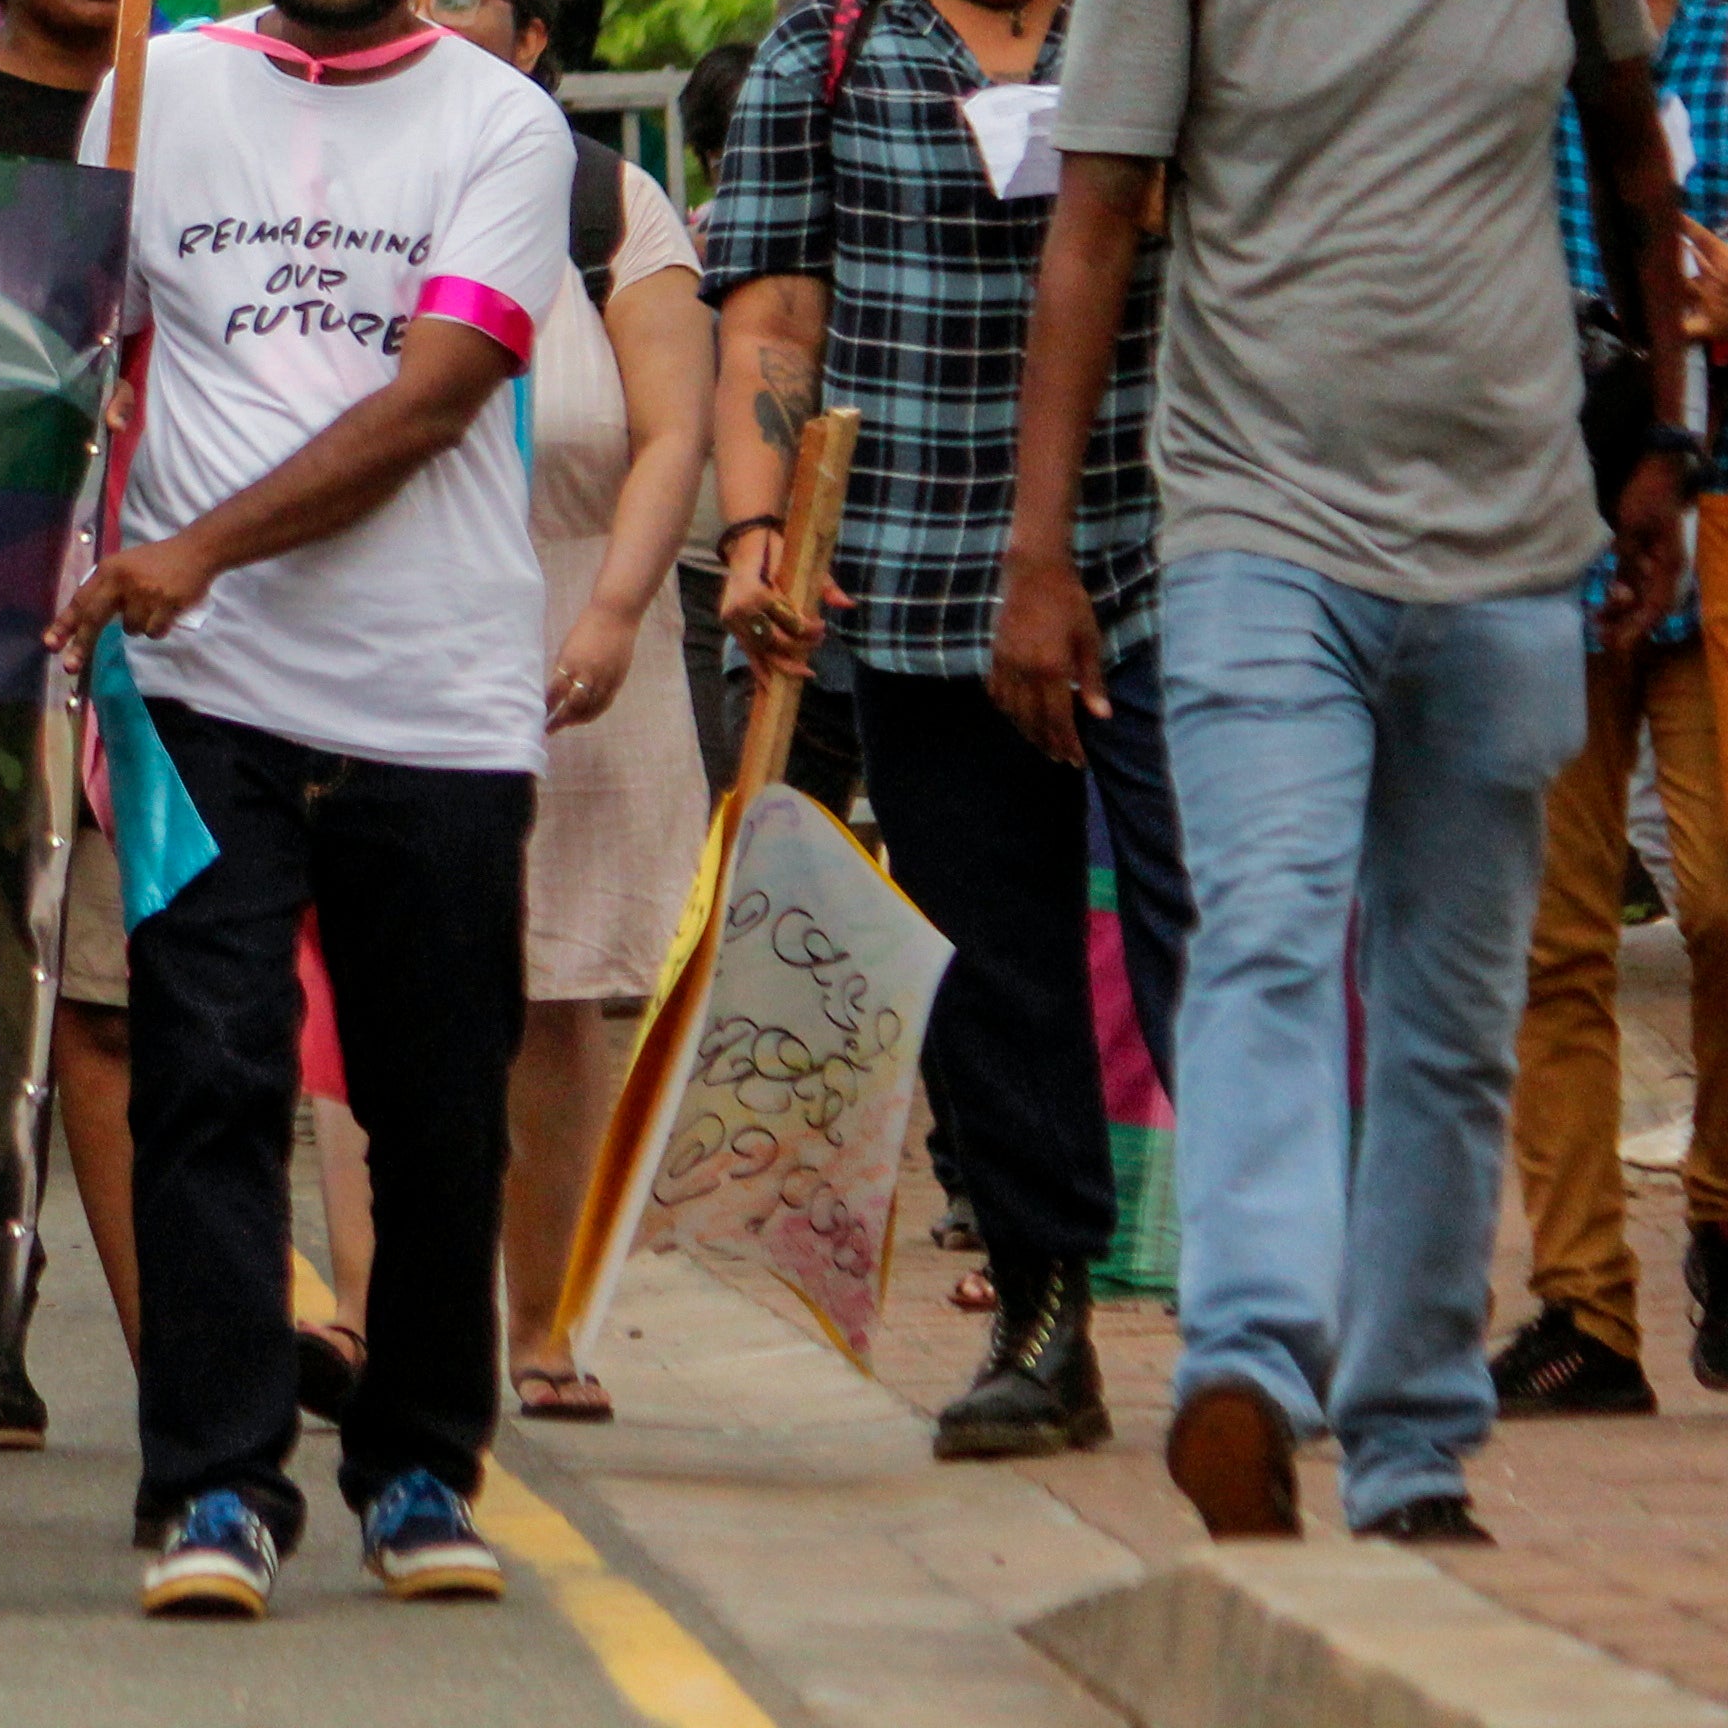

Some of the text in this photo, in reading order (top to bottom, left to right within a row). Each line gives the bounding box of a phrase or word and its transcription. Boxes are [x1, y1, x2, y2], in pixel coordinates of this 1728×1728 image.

[178, 216, 432, 267] REIMAGINING
[265, 263, 348, 294] OUR
[225, 299, 410, 356] FUTURE
